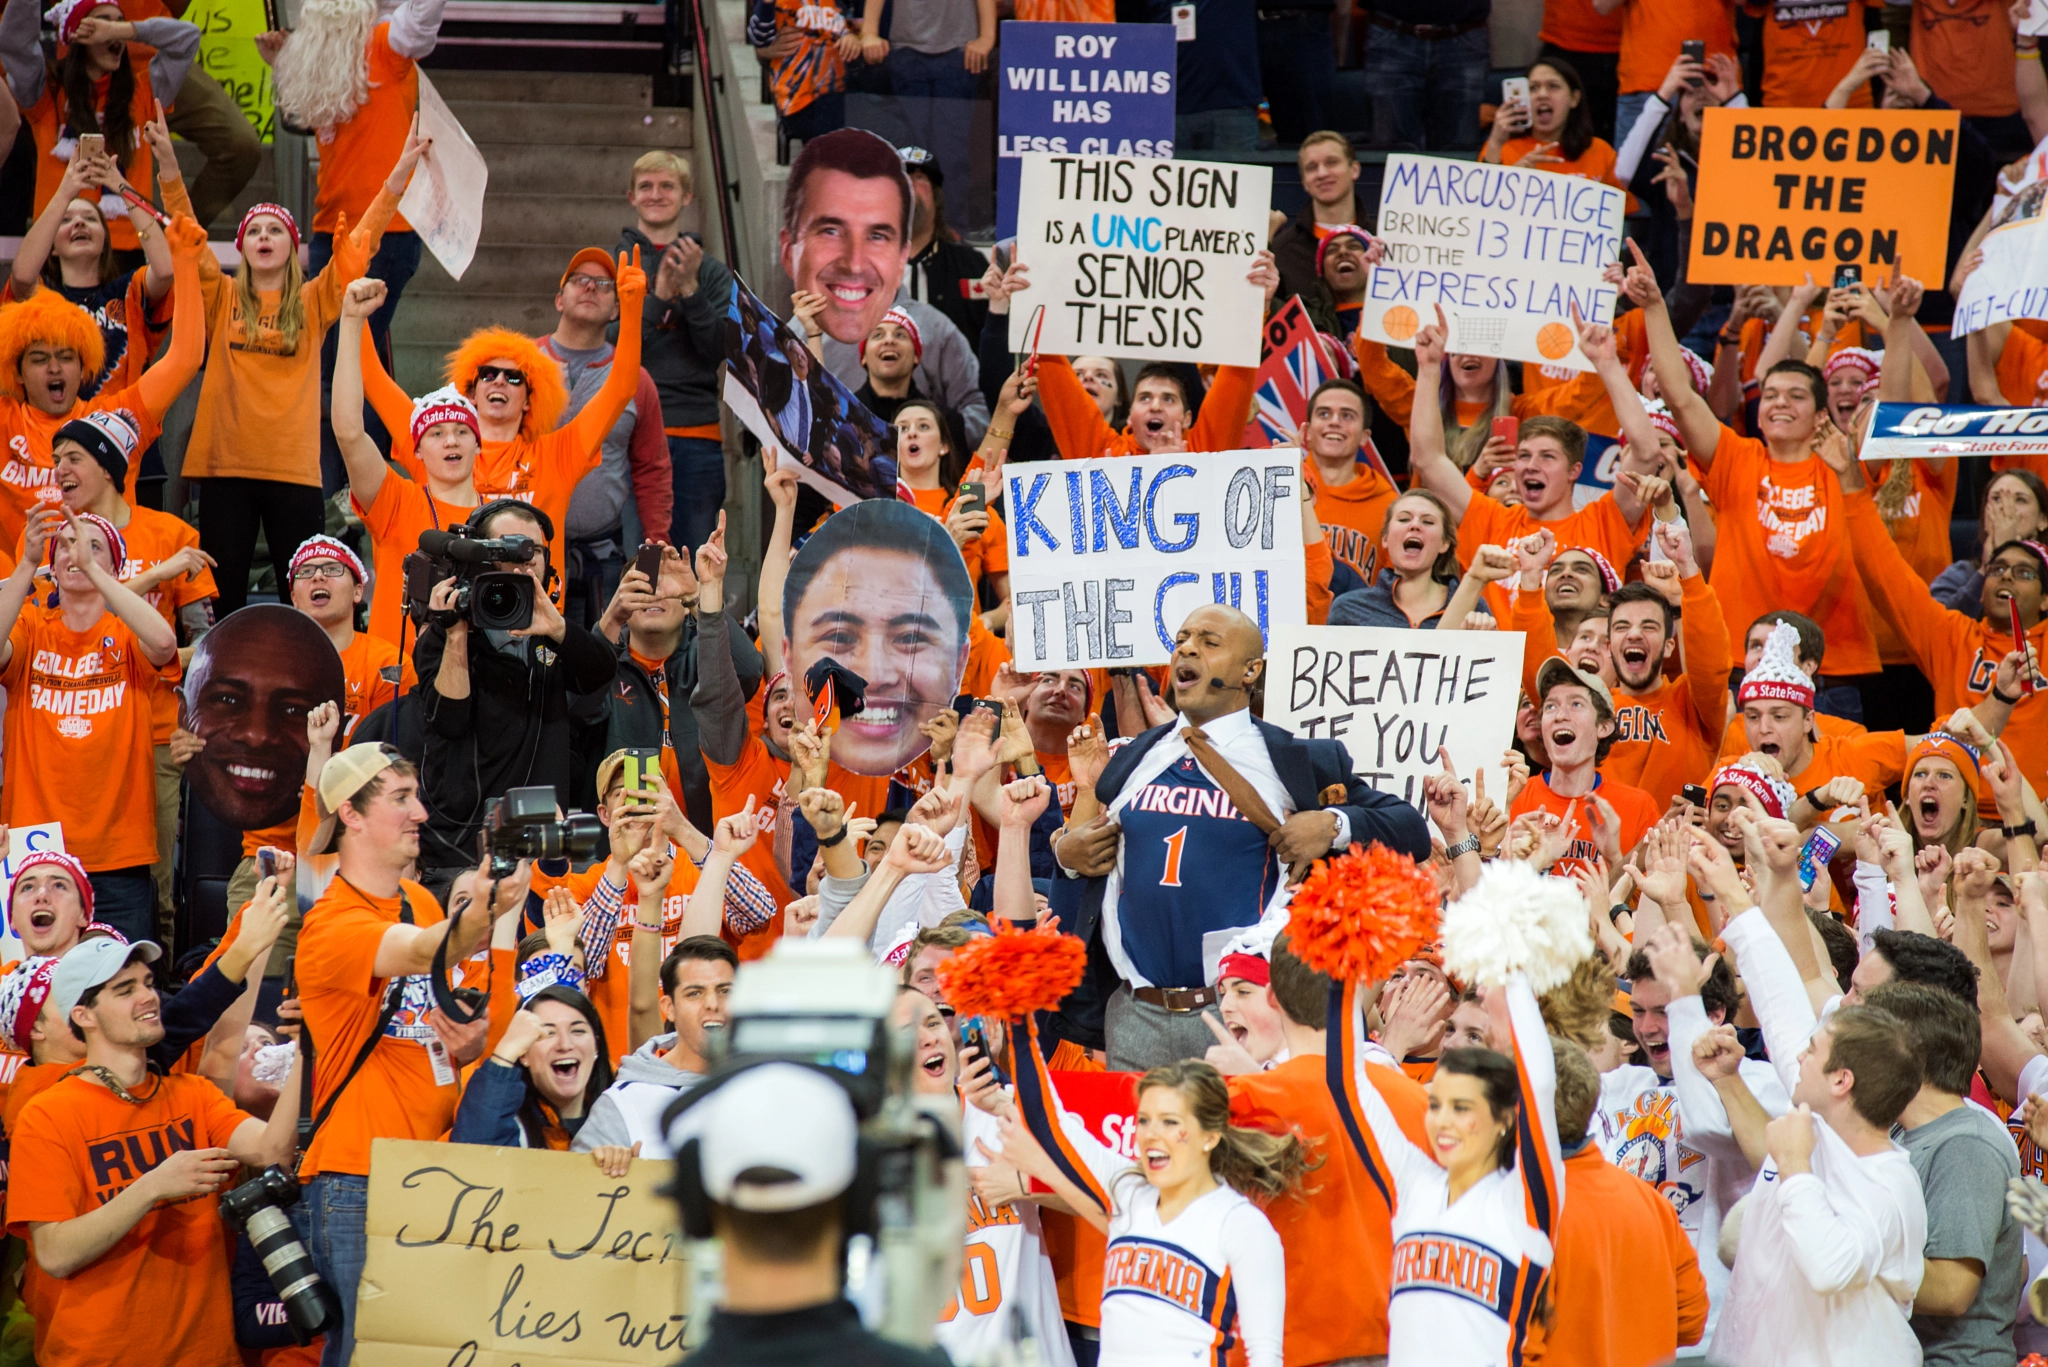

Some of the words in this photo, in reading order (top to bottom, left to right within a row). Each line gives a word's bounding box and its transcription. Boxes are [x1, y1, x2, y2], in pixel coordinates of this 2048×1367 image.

[1055, 36, 1117, 58] ROY
[1007, 67, 1171, 94] WILLIAMS
[1052, 101, 1112, 124] HAS
[998, 136, 1068, 157] LESS
[1080, 138, 1174, 159] CLASS
[1731, 124, 1954, 165] BROGDON
[1050, 158, 1135, 203] THIS
[1150, 164, 1238, 208] SIGN
[1774, 174, 1866, 213] THE
[1046, 220, 1063, 244] IS
[1069, 222, 1086, 245] A
[1092, 213, 1162, 253] UNC
[1384, 211, 1470, 237] BRINGS
[1477, 219, 1509, 258] 13
[1524, 225, 1618, 269] ITEMS
[1702, 222, 1898, 265] DRAGON
[1426, 246, 1465, 266] THE
[1075, 253, 1205, 300] SENIOR
[1371, 267, 1519, 309] EXPRESS
[1526, 280, 1617, 325] LANE
[1065, 301, 1204, 349] THESIS
[1010, 464, 1200, 556] KING
[1224, 466, 1294, 550] OF
[1016, 579, 1134, 662] THE
[32, 650, 104, 678] COLLEGE
[1290, 645, 1496, 712] BREATHE
[31, 681, 127, 715] GAMEDAY
[1759, 684, 1786, 699] State
[1786, 689, 1805, 702] Farm
[1373, 712, 1448, 768] YOU
[1131, 784, 1250, 822] VIRGINI
[1728, 771, 1751, 786] State
[1750, 780, 1771, 803] Farm
[40, 851, 69, 867] Farm
[1159, 826, 1188, 887] 1
[520, 953, 574, 978] HAPPY
[890, 944, 911, 966] Stat
[521, 972, 555, 995] GAME
[89, 1118, 195, 1187] RUN
[396, 1166, 520, 1254] The
[488, 1264, 582, 1342] lies
